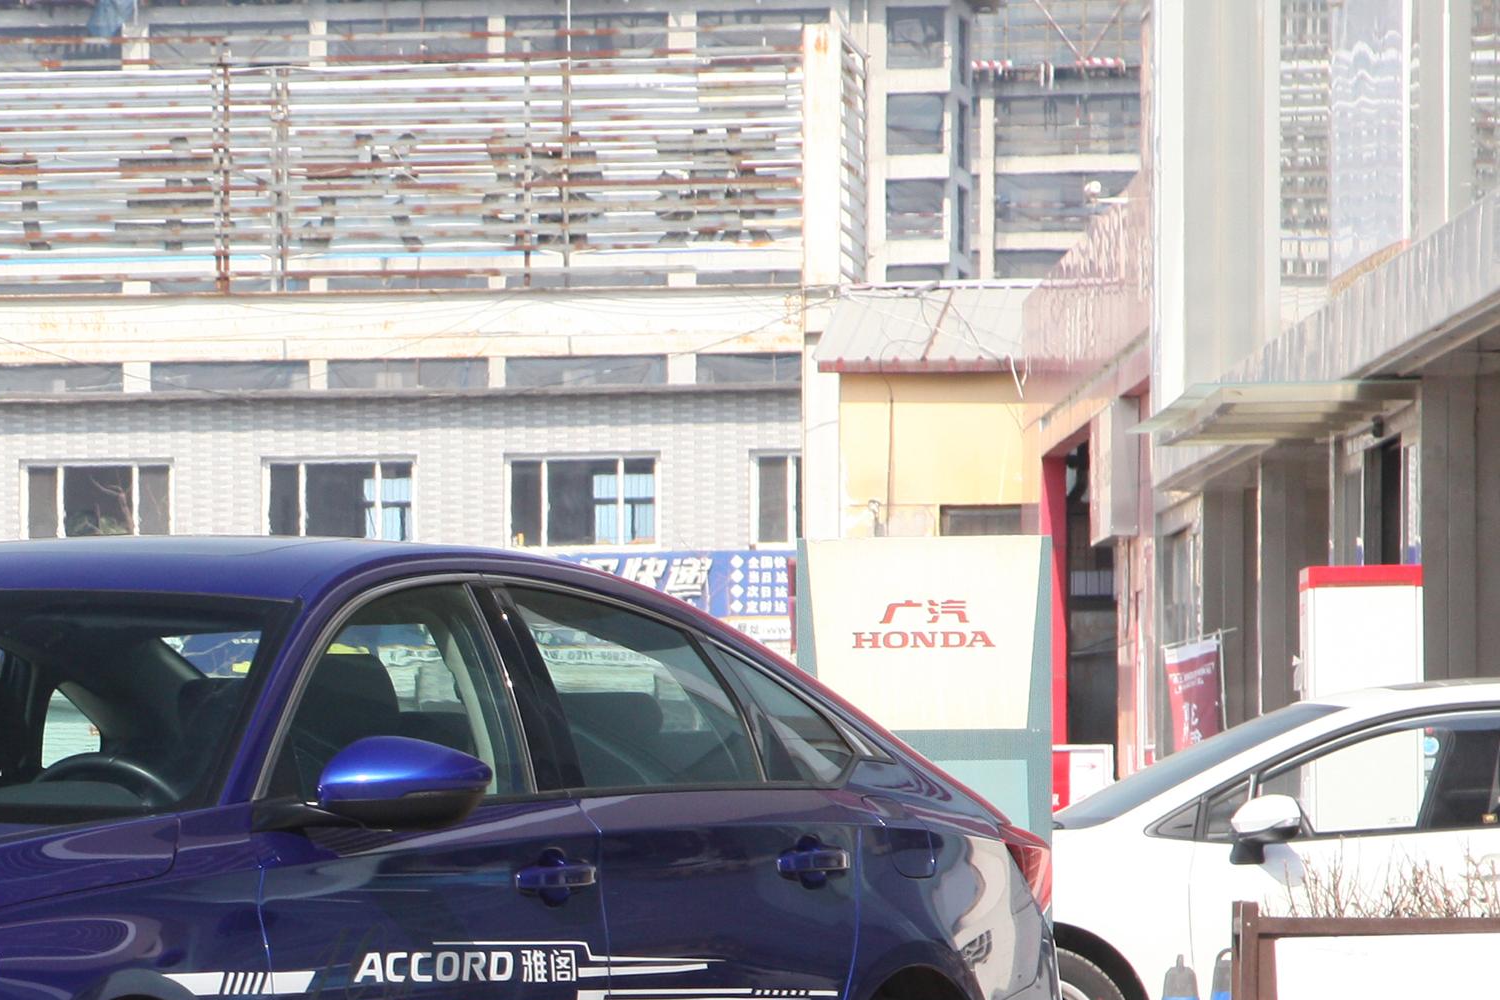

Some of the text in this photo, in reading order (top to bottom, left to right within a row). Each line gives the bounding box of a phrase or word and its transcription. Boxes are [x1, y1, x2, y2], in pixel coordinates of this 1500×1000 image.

[580, 557, 715, 598] 快递
[879, 599, 970, 624] 广汽
[852, 630, 996, 649] HONDA
[354, 950, 577, 983] ACCORD 雅阁
